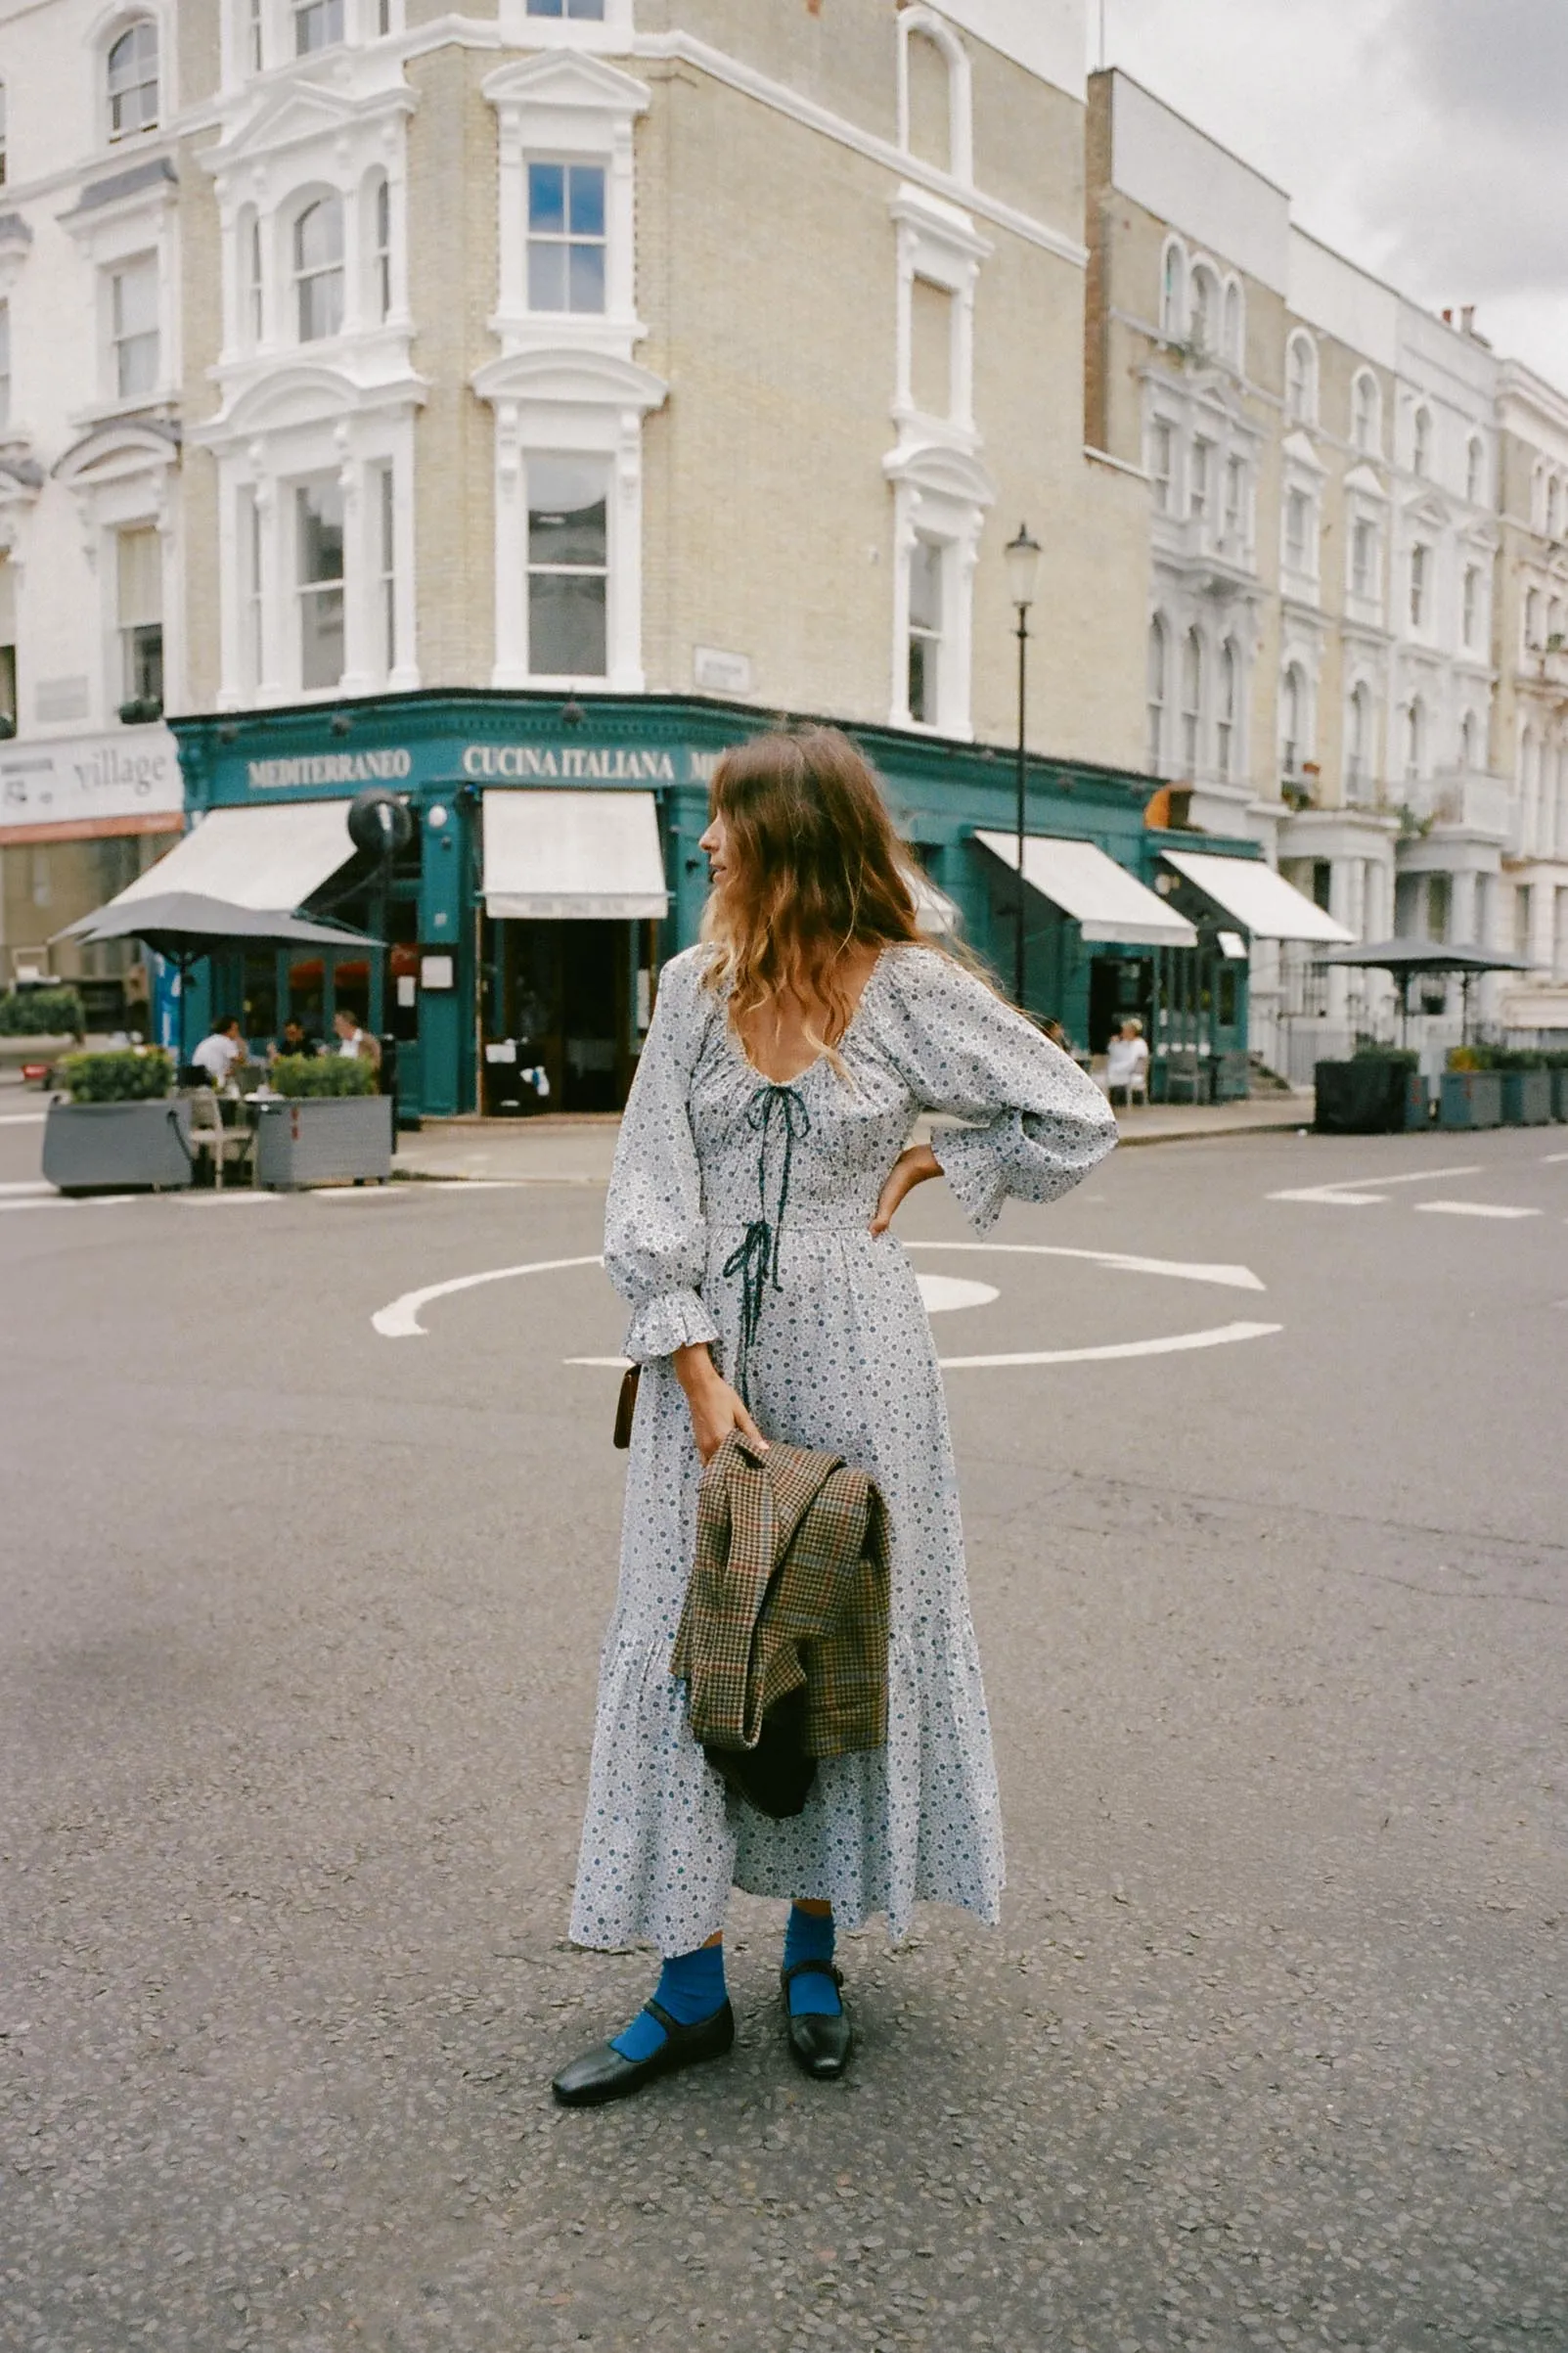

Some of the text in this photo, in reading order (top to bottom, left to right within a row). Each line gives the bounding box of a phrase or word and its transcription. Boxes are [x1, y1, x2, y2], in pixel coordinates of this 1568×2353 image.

[72, 748, 167, 797] village
[248, 748, 412, 789] MEDITERRANEO
[463, 746, 559, 778] CUCINA
[561, 748, 675, 780] ITALIANA
